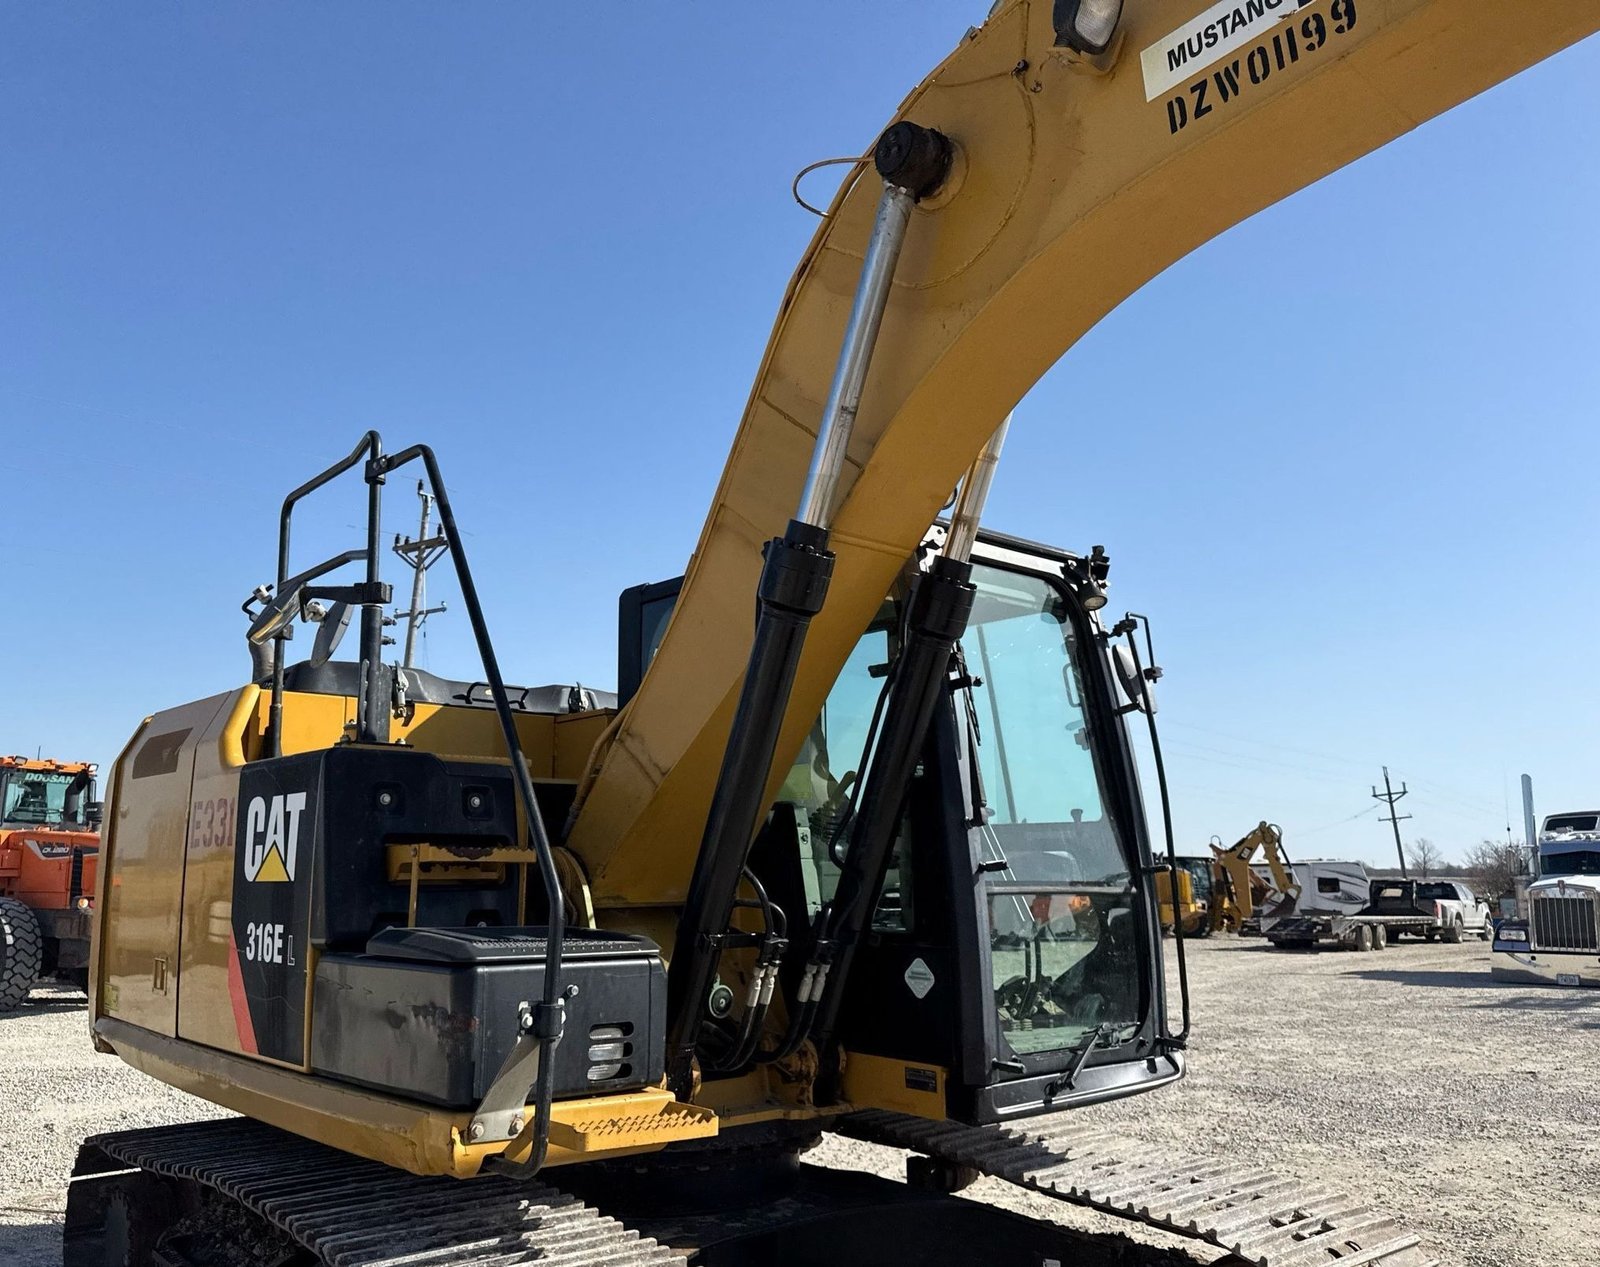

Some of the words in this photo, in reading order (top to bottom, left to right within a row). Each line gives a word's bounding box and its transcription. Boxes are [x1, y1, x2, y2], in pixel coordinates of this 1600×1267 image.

[244, 791, 306, 882] CAT
[245, 921, 284, 964] 316E
[287, 934, 295, 966] L
